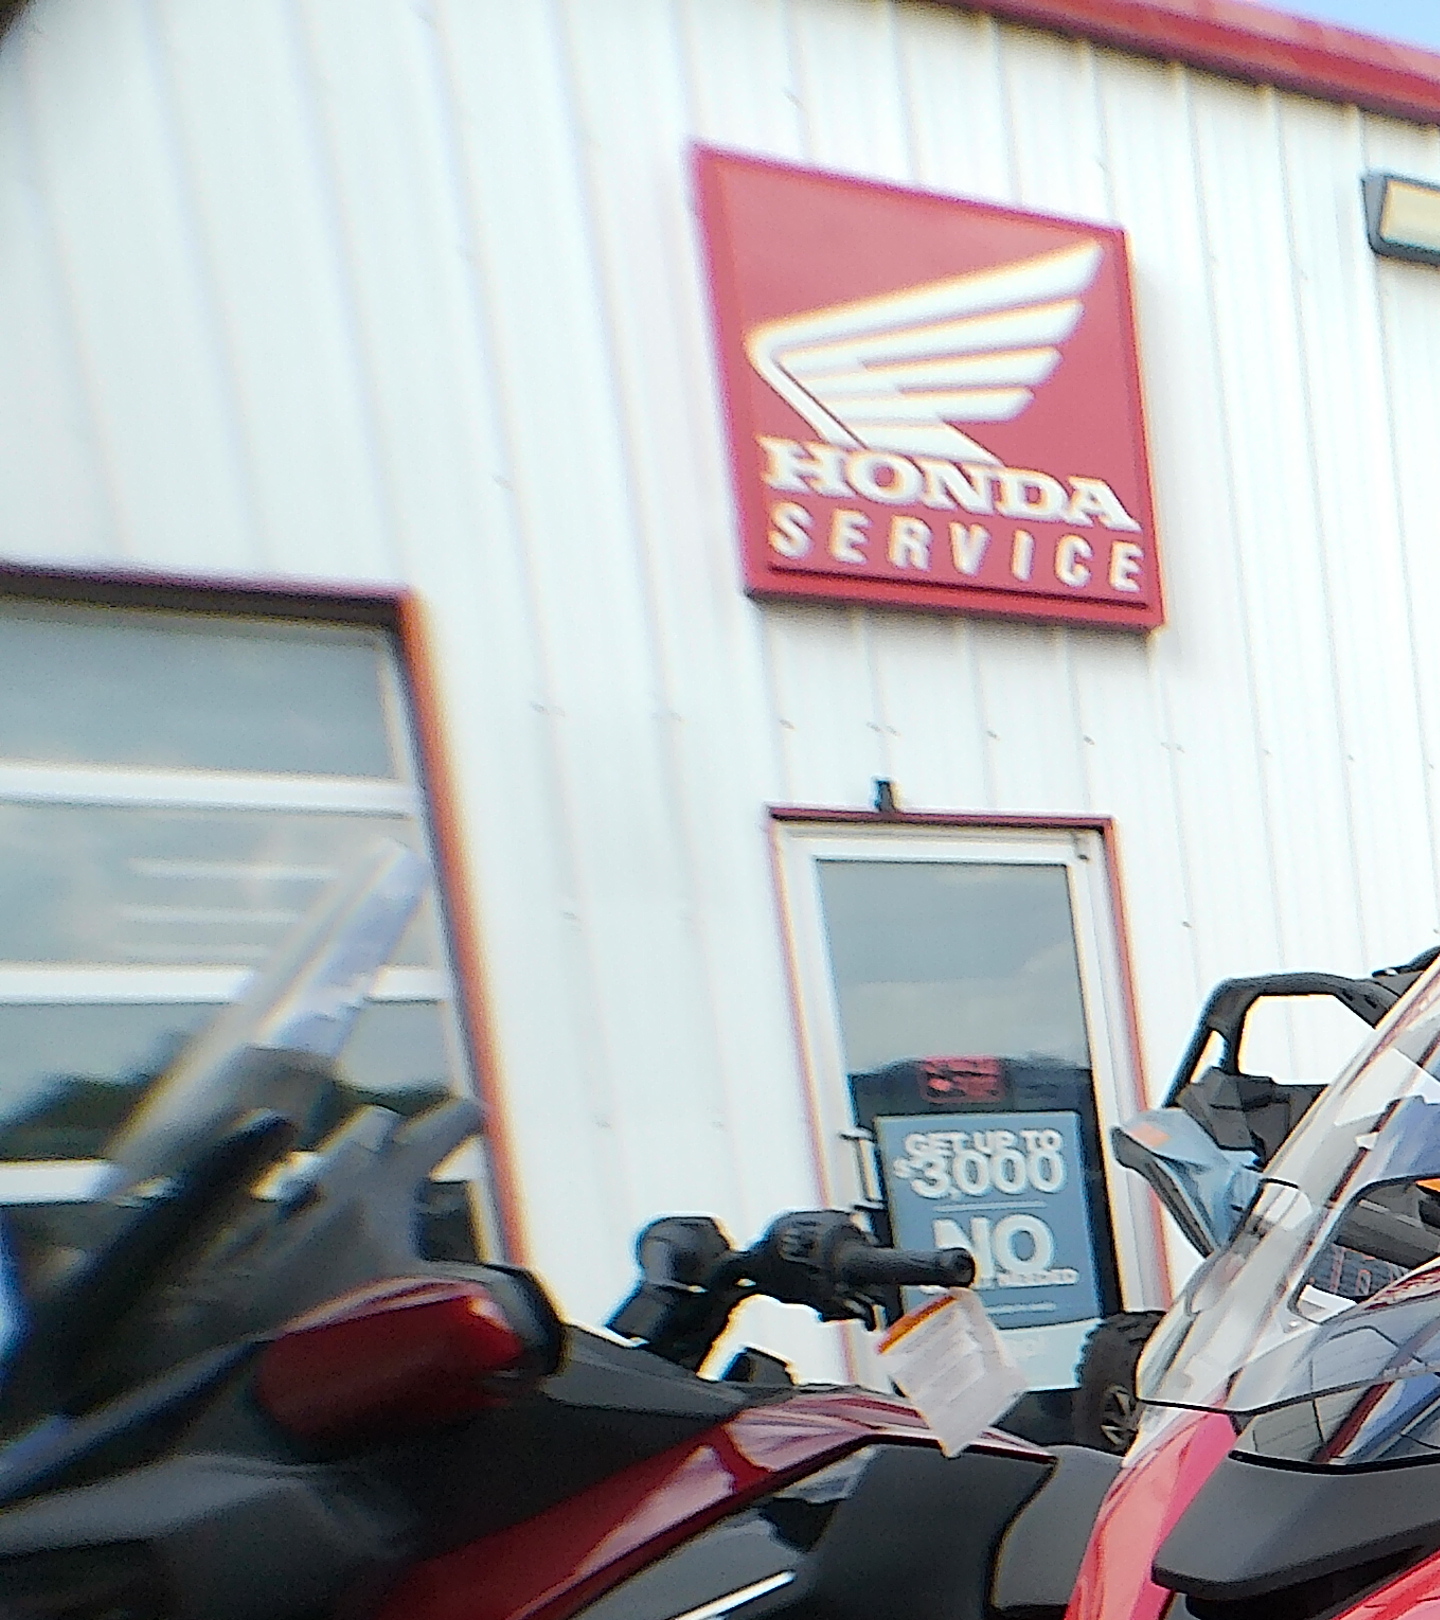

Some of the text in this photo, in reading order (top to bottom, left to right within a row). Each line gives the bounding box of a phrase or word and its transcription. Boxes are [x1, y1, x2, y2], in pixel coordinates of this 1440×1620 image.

[756, 433, 1142, 531] HONDA
[768, 502, 1144, 592] SERVICE
[904, 1128, 1063, 1156] GET UP TO
[932, 1213, 1055, 1282] NO
